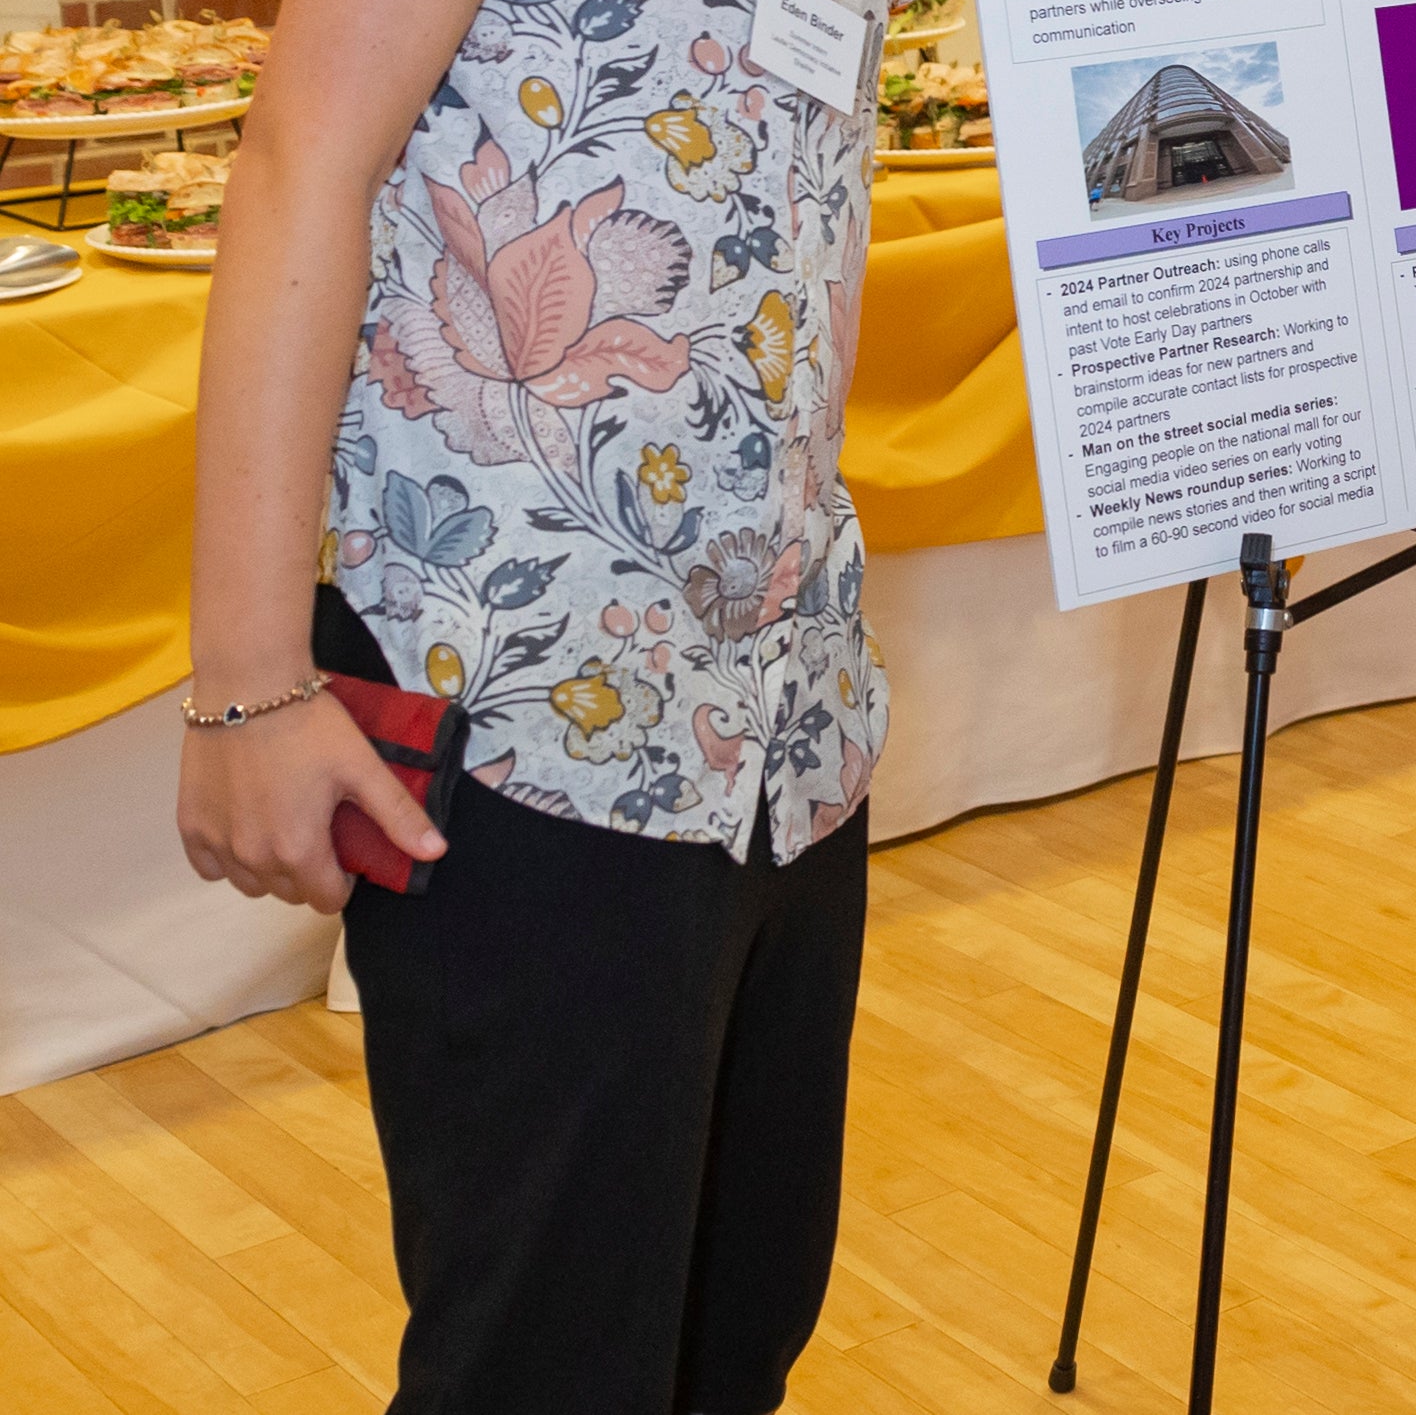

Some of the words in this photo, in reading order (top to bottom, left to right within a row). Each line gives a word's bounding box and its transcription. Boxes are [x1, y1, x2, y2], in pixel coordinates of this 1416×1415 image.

[809, 13, 845, 42] Binder
[1151, 227, 1181, 247] Key
[1185, 218, 1246, 239] Projects
[1065, 318, 1104, 337] intent
[1105, 317, 1119, 330] to
[1122, 310, 1152, 327] host
[1153, 297, 1232, 321] celebrations
[1234, 293, 1246, 306] in
[1248, 284, 1299, 304] October
[1300, 278, 1327, 294] with
[1070, 352, 1155, 377] Prospective
[1158, 341, 1210, 361] Partner
[1212, 326, 1280, 351] Research:
[1282, 318, 1334, 337] Working
[1336, 315, 1349, 327] to
[1081, 442, 1112, 458] Man
[1115, 437, 1135, 451] on
[1137, 431, 1161, 446] the
[1163, 421, 1204, 441] street
[1206, 411, 1248, 432] social
[1250, 403, 1291, 423] media
[1293, 395, 1338, 414] series:
[1089, 496, 1141, 518] Weekly
[1144, 488, 1184, 506] News
[1186, 475, 1245, 497] roundup
[1247, 464, 1293, 484] series:
[1295, 452, 1347, 473] Working
[1348, 449, 1362, 461] to
